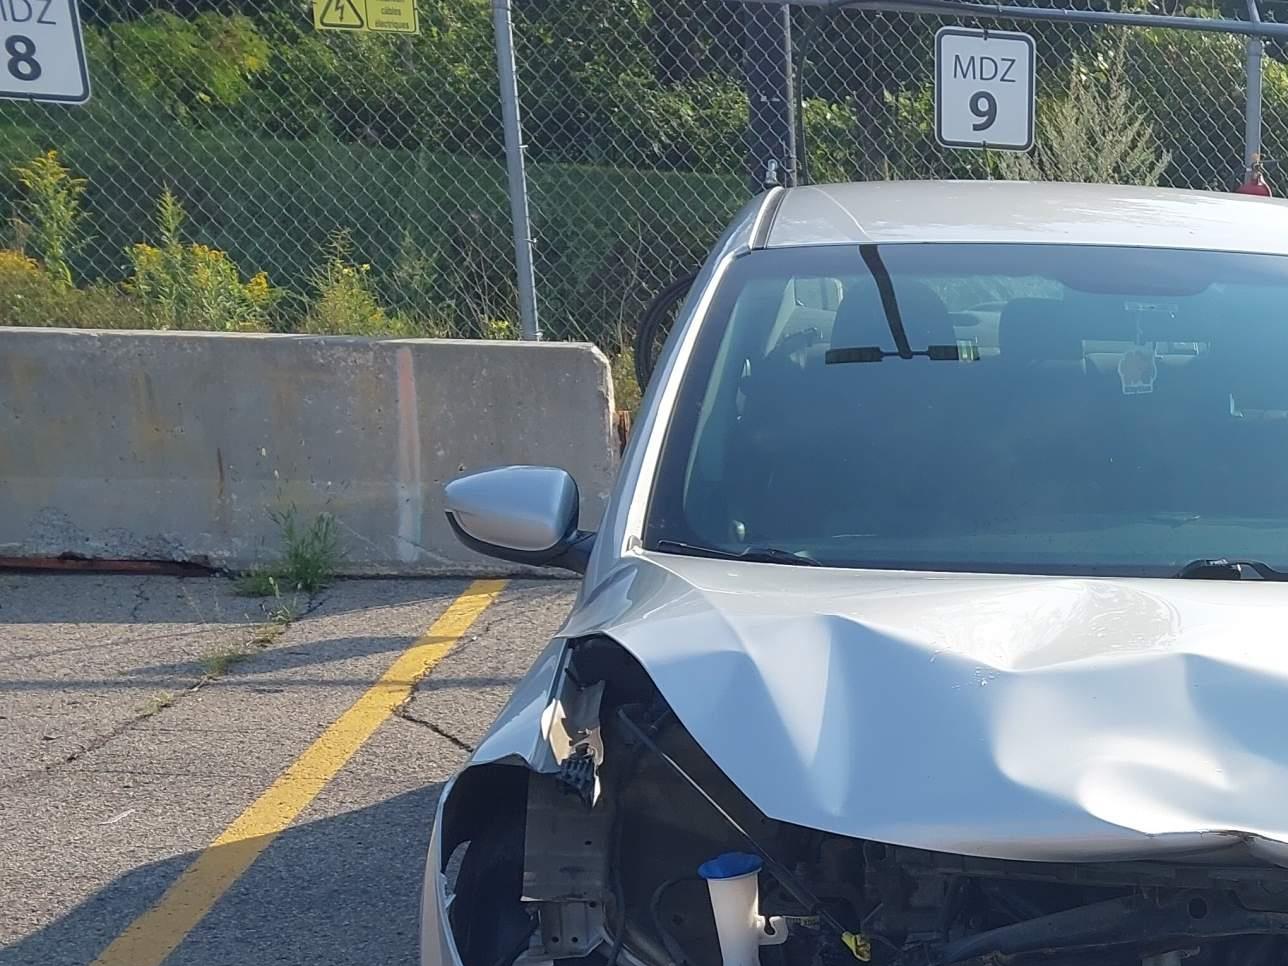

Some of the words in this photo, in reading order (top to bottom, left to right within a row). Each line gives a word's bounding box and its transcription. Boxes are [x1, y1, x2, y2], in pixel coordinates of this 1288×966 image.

[0, 0, 57, 25] DZ
[5, 35, 42, 81] 8
[953, 54, 1017, 82] MDZ
[969, 91, 998, 131] 9
